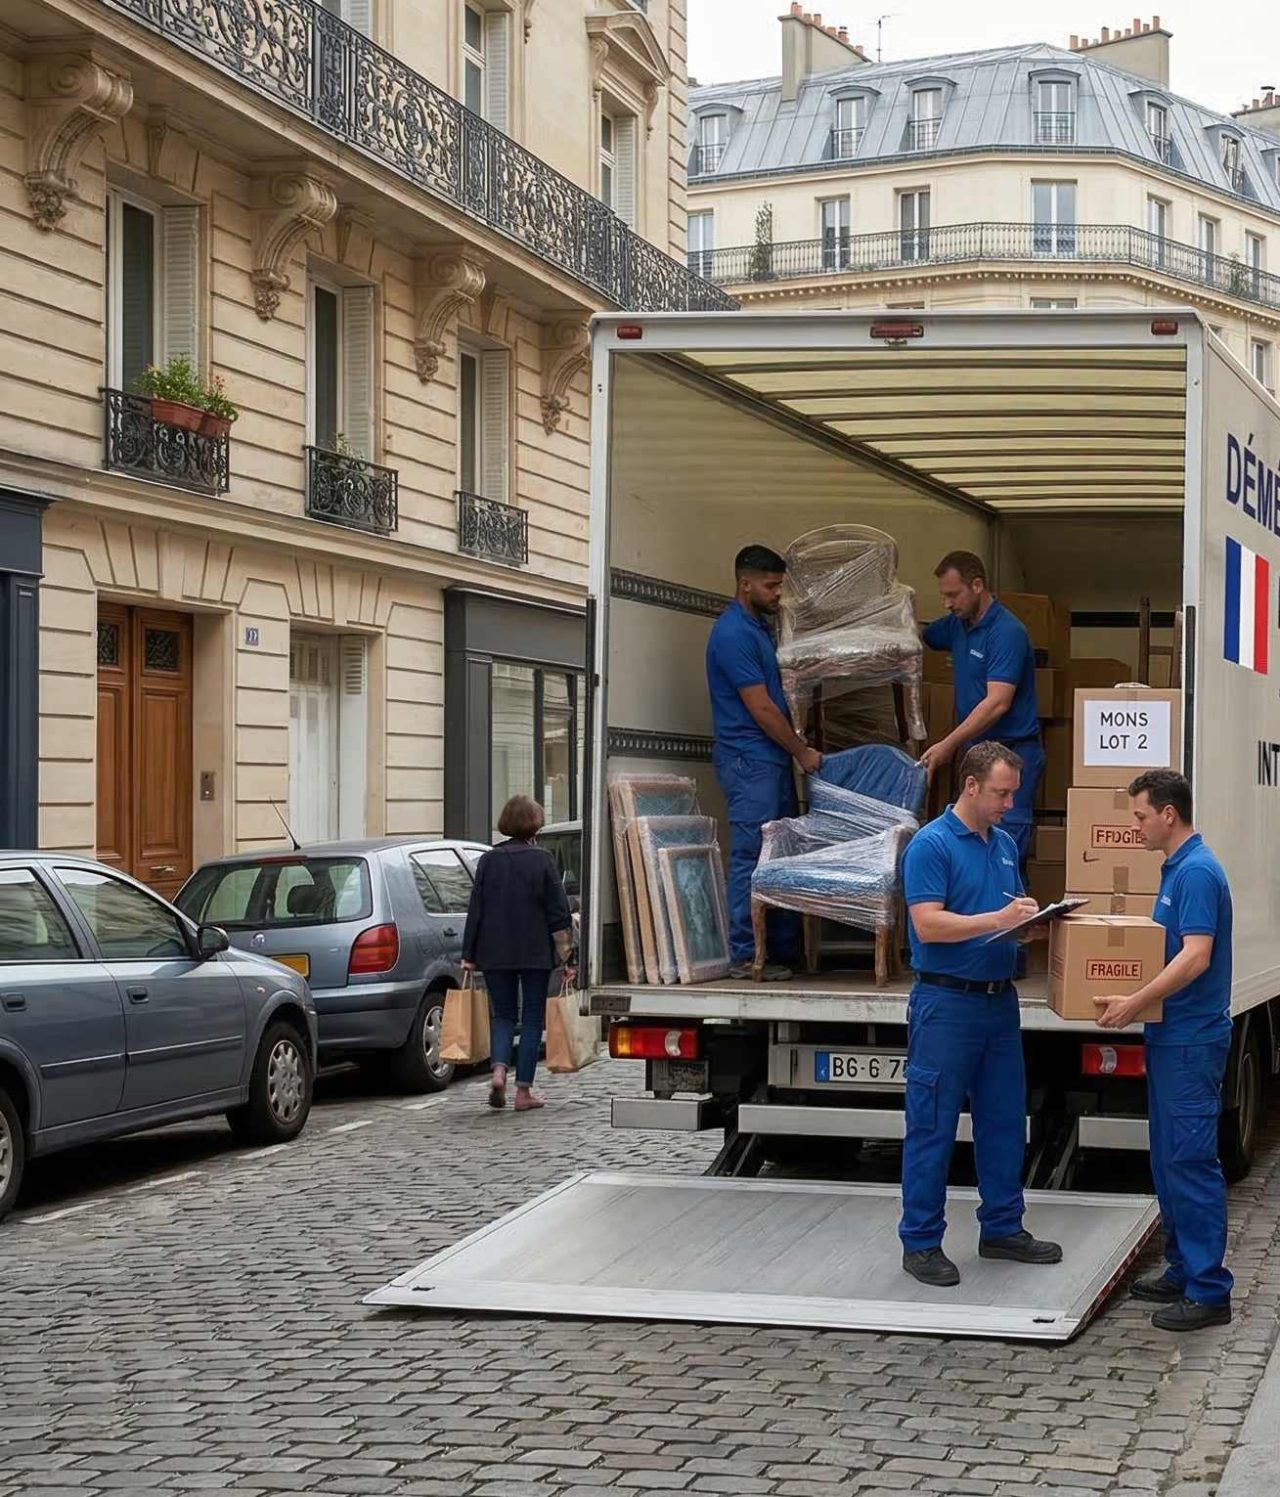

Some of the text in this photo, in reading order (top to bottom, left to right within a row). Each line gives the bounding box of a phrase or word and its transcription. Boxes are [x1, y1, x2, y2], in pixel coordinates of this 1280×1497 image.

[1100, 711, 1149, 728] MONS
[1099, 734, 1148, 750] LOT 2
[1091, 963, 1139, 977] FRAGILE
